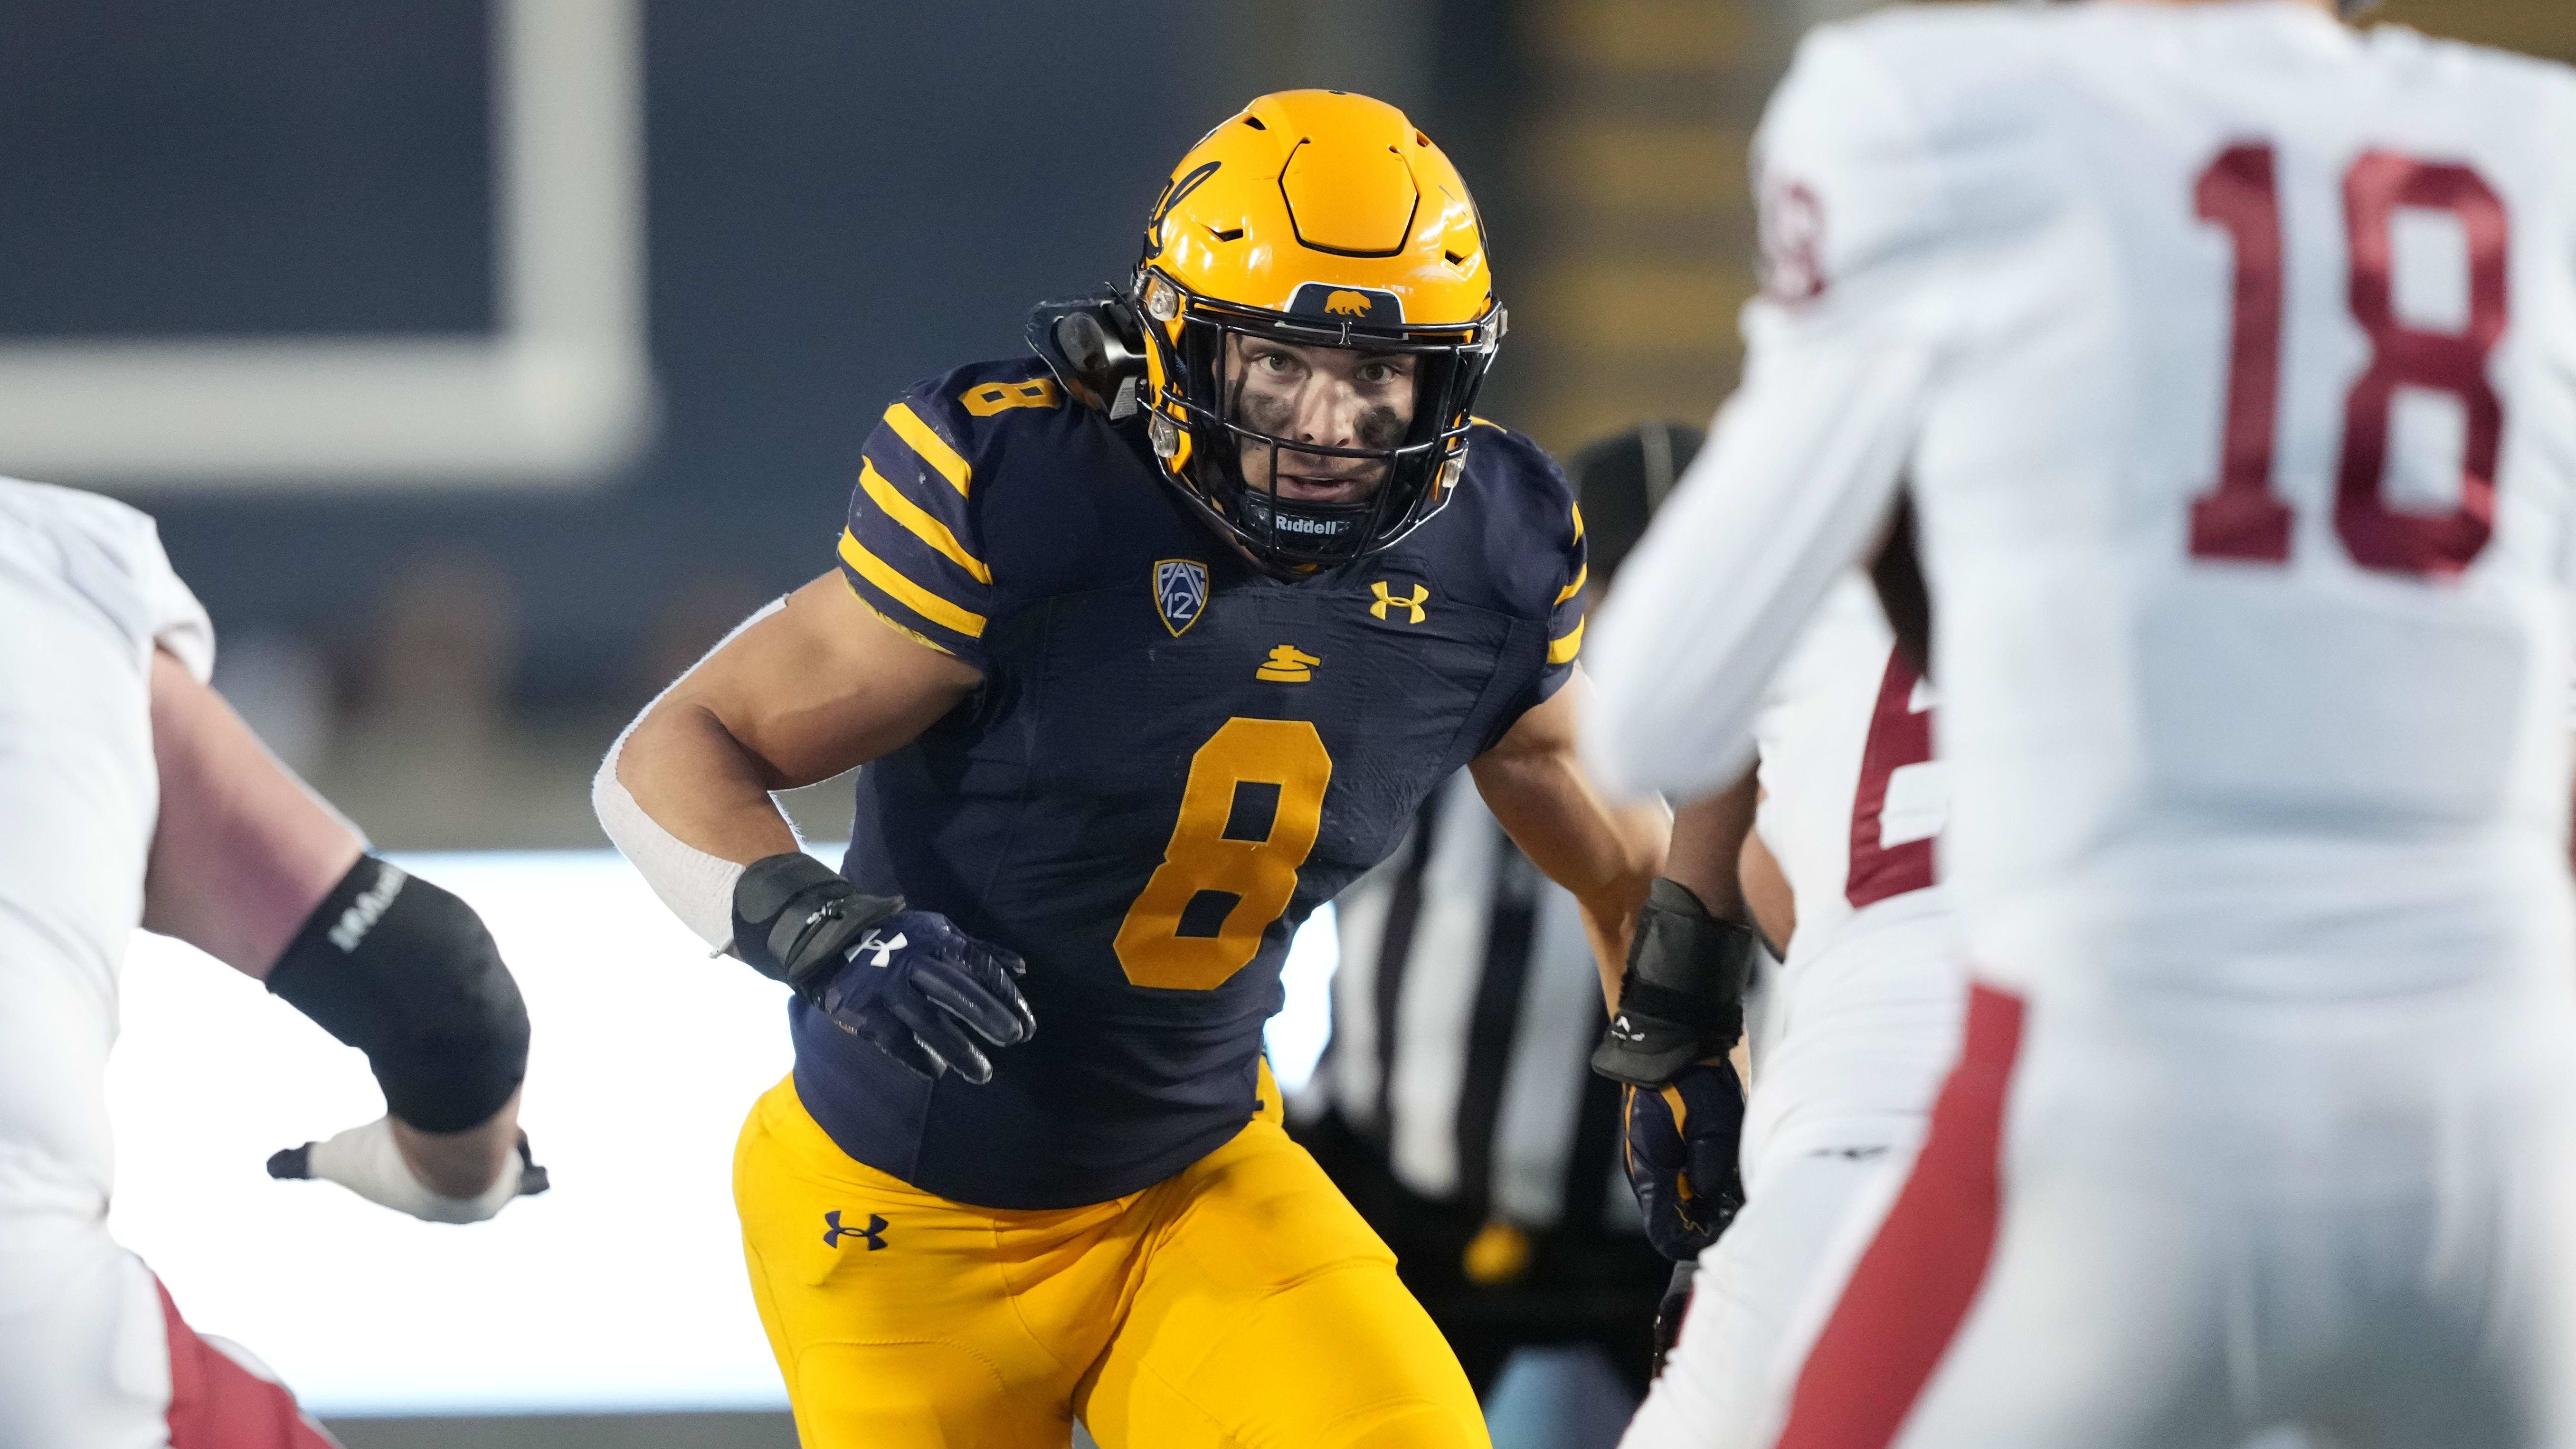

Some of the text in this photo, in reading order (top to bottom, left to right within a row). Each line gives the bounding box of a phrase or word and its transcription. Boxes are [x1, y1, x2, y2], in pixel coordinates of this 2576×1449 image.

[2188, 139, 2510, 587] 18
[958, 378, 1061, 417] 8
[1276, 515, 1336, 534] Riddell
[1157, 562, 1205, 606] PAC
[1166, 592, 1193, 619] 12
[1114, 717, 1332, 990] 8
